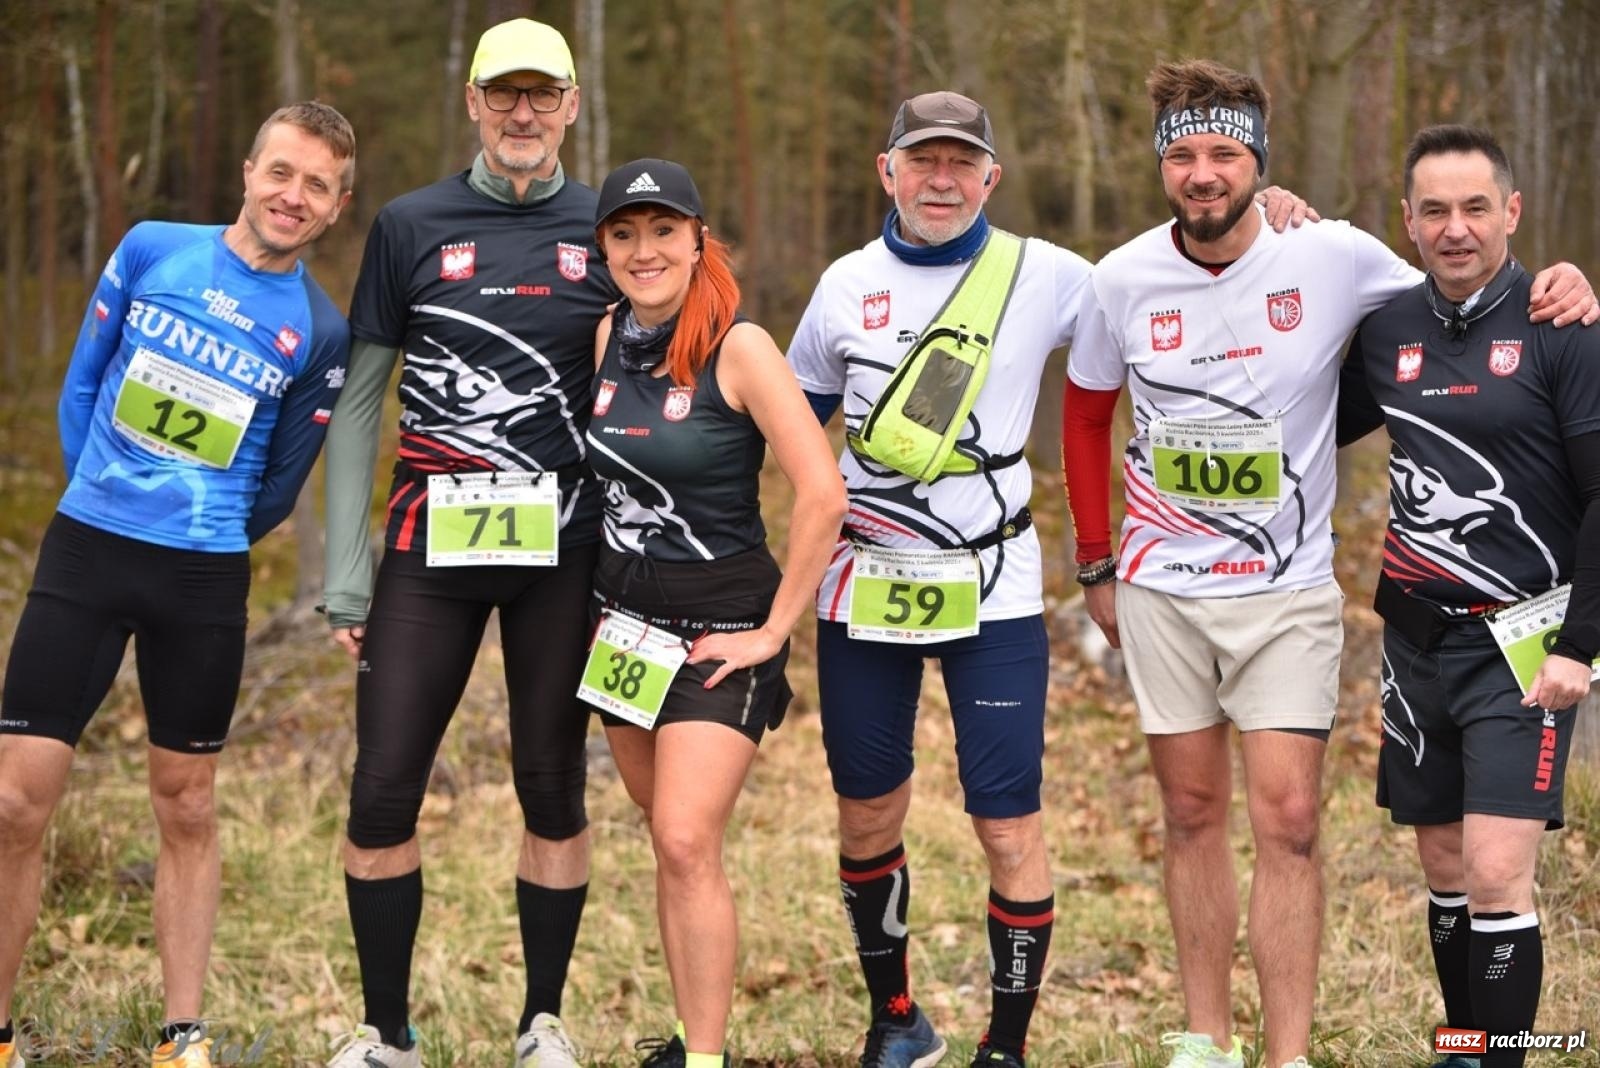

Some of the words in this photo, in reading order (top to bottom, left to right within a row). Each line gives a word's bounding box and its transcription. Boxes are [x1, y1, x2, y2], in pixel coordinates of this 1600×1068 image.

[1171, 107, 1253, 133] EASYRUN
[1171, 122, 1254, 145] NONSTOP
[626, 185, 660, 194] adidas
[1150, 309, 1181, 317] POLSKA
[146, 399, 207, 451] 12
[1172, 454, 1262, 495] 106
[463, 507, 522, 547] 71
[883, 583, 945, 625] 59
[603, 653, 647, 700] 38
